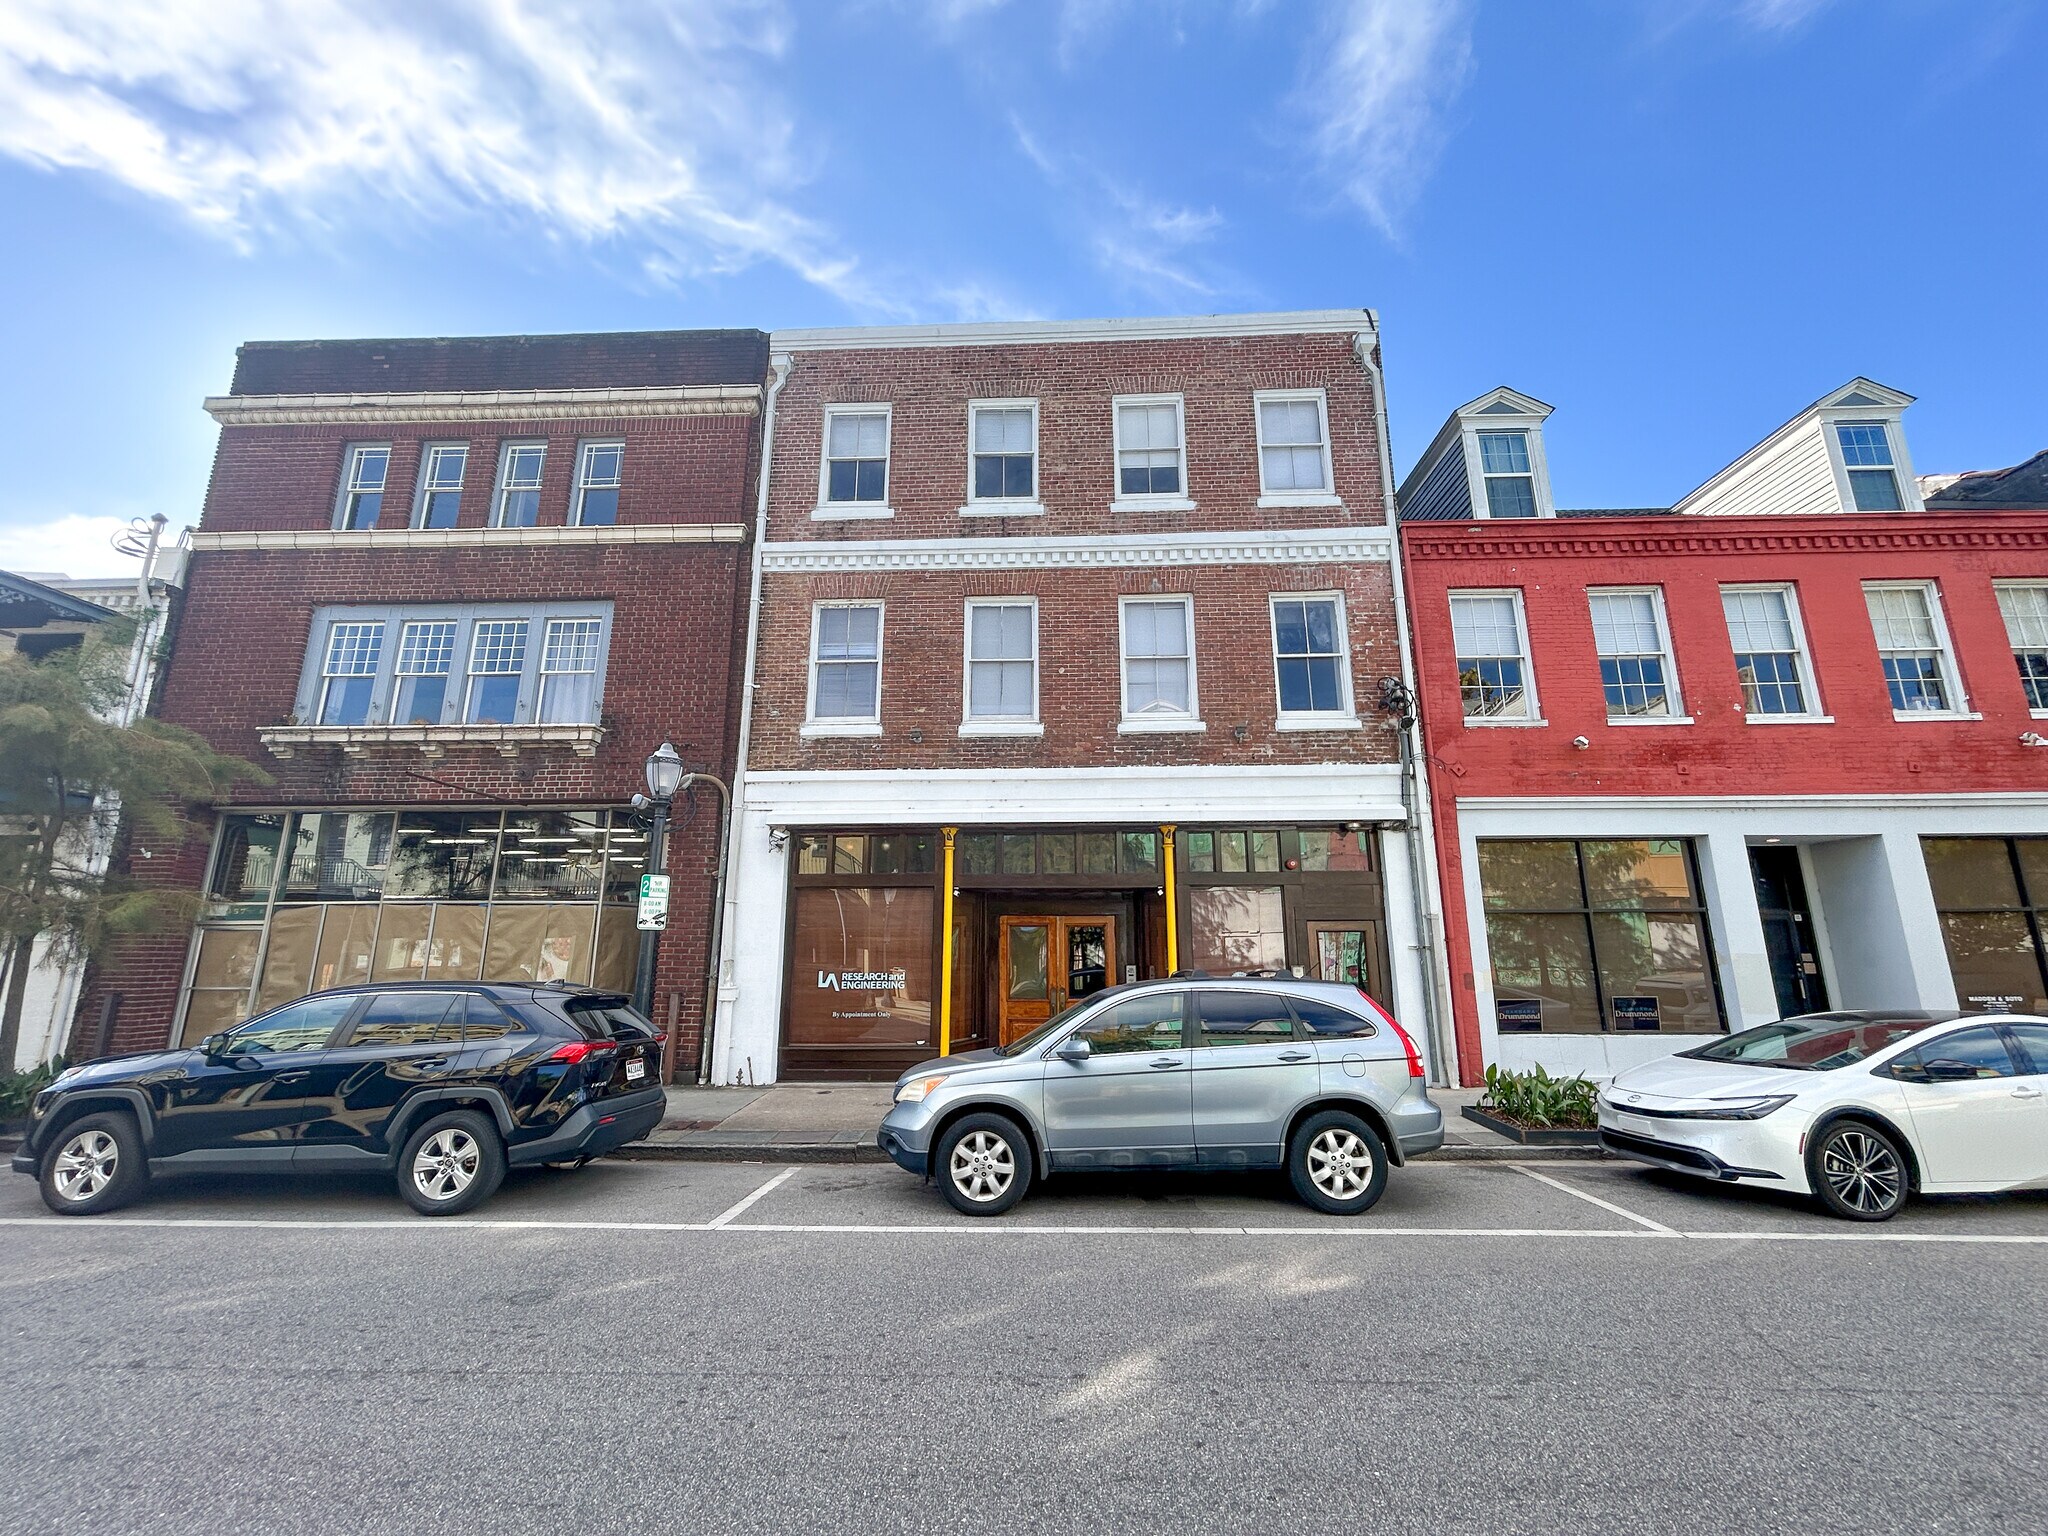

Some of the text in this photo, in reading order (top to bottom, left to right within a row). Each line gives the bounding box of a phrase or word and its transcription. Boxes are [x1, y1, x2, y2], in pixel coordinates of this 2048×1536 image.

[643, 880, 649, 892] 2
[817, 970, 906, 992] LA RESEARCH and
[841, 981, 906, 990] ENGINEERING
[1499, 1012, 1541, 1020] Drummond
[1615, 1010, 1658, 1018] Drummond
